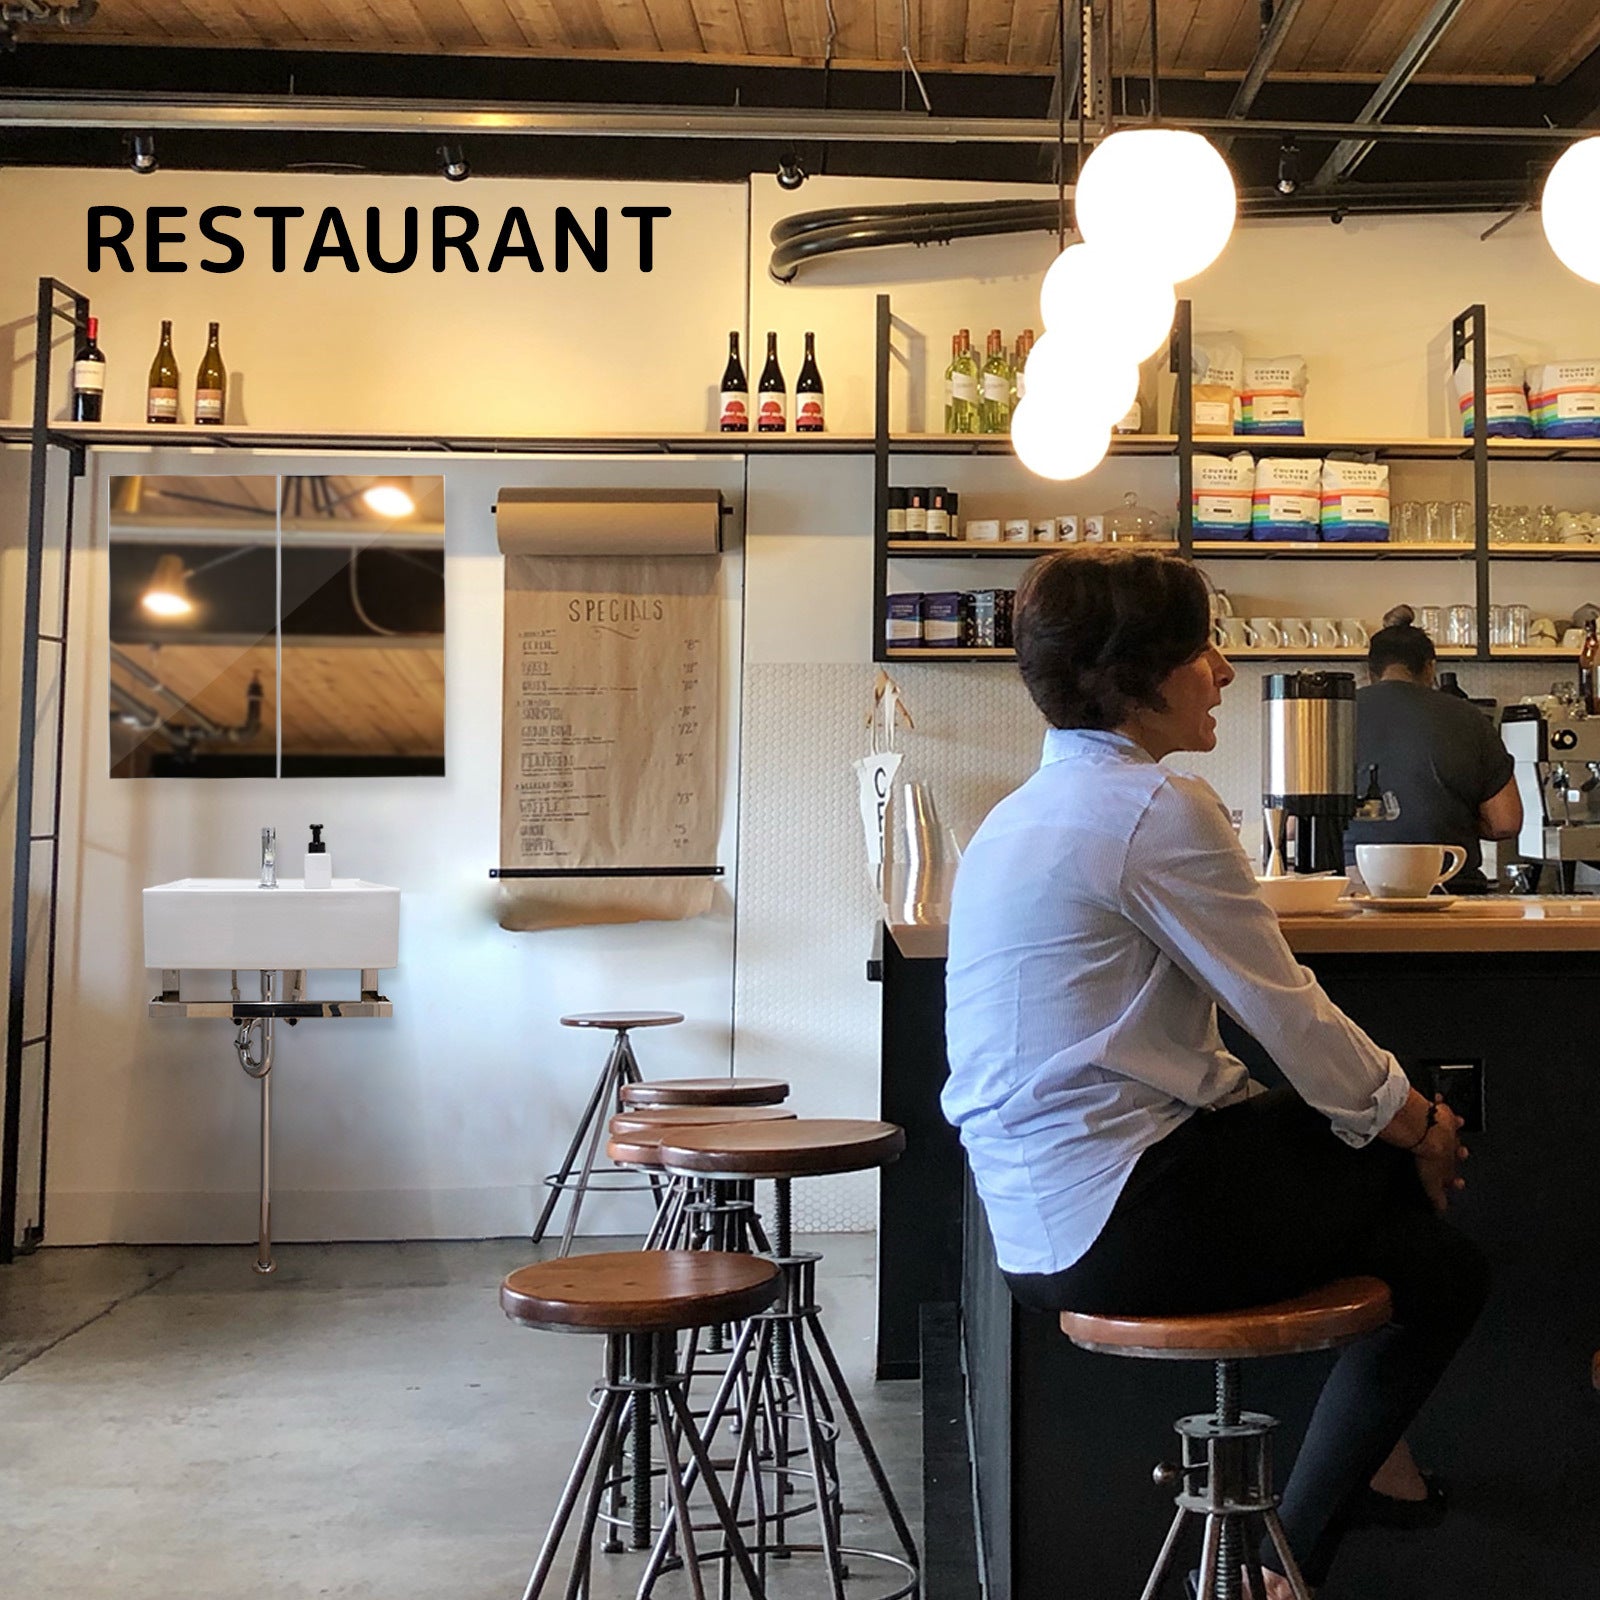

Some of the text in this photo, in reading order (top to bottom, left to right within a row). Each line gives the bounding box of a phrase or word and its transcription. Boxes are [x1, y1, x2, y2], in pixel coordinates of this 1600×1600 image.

[86, 205, 673, 274] RESTAURANT
[1273, 473, 1309, 481] CULTURE
[568, 598, 664, 623] SPECIALS
